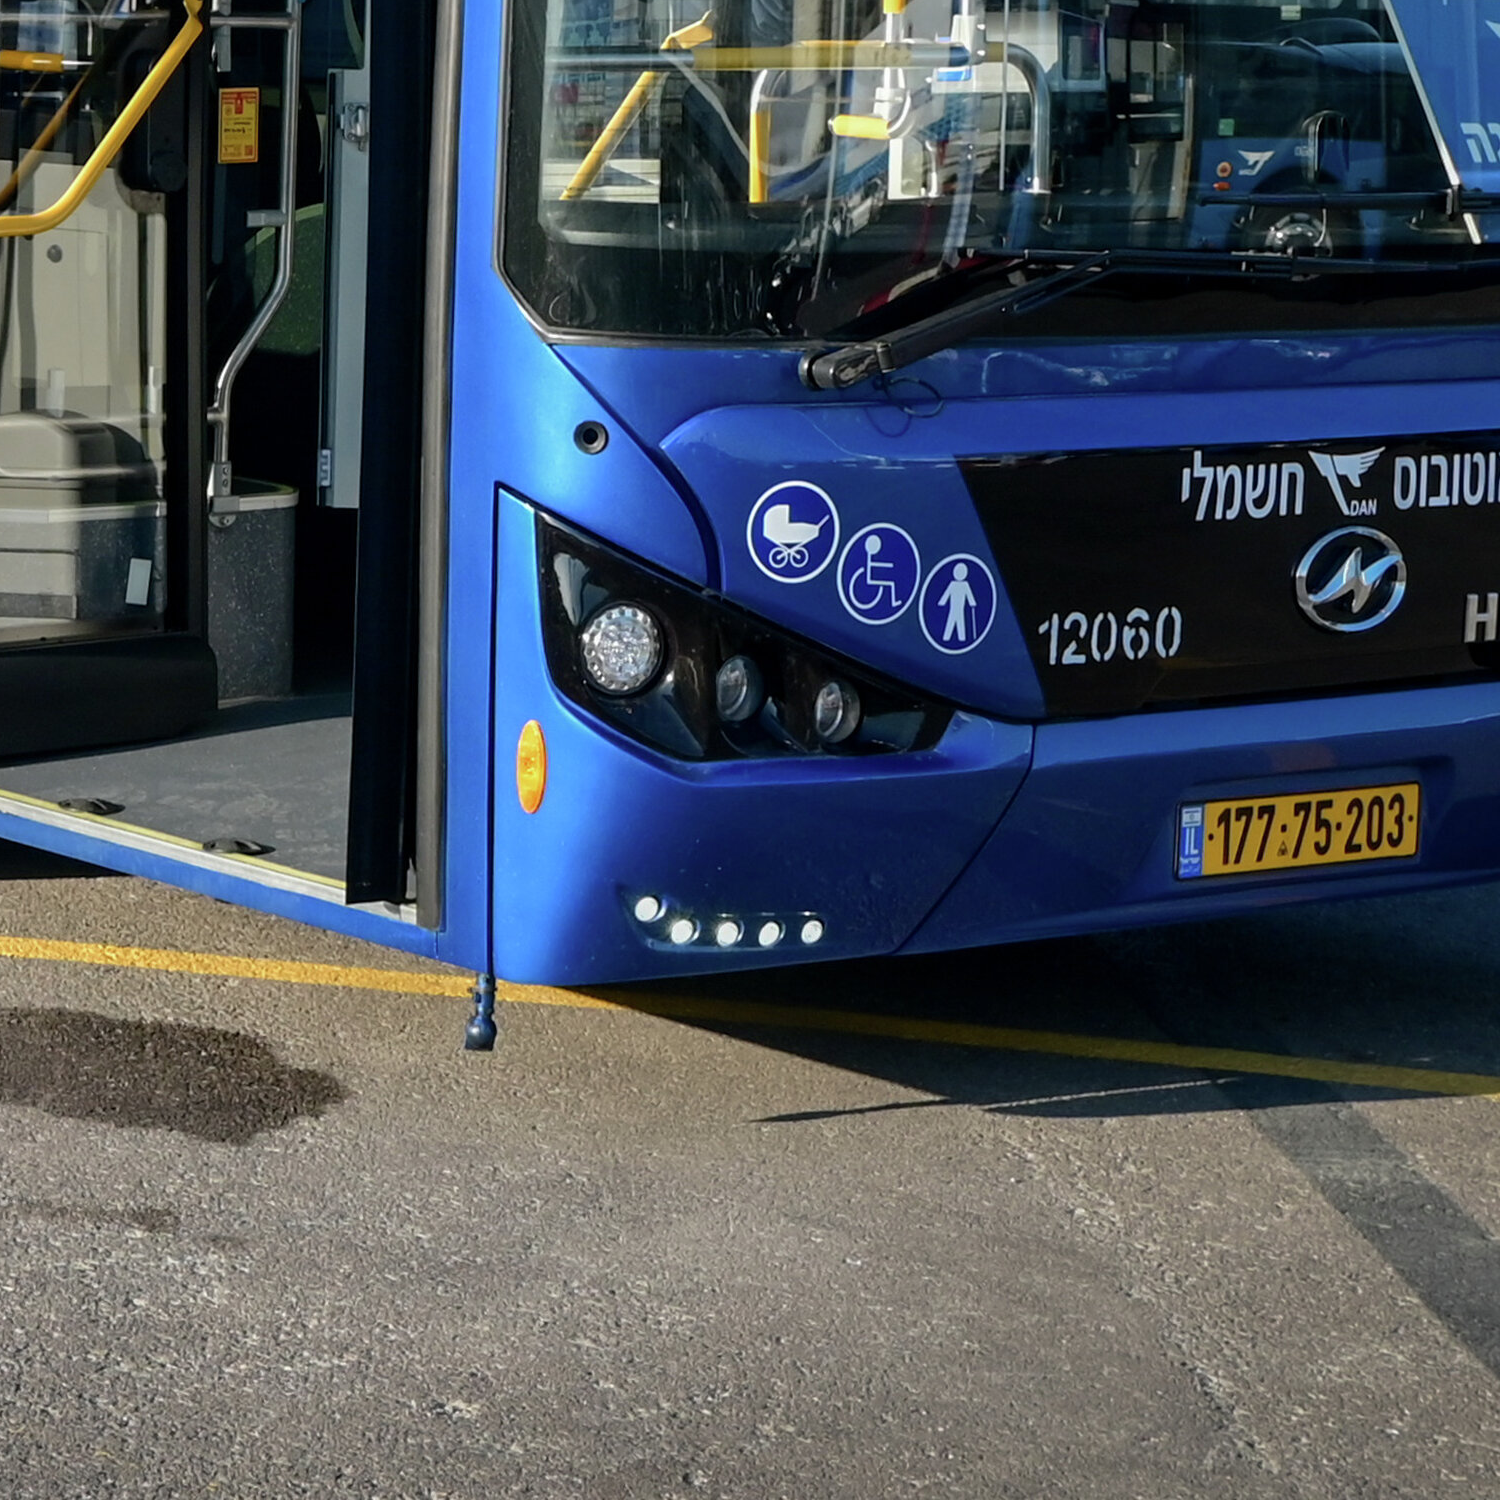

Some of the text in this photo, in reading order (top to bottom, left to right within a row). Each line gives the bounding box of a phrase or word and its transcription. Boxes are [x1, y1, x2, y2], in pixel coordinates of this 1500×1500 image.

[1181, 450, 1500, 521] וטובוס חשמלי
[1349, 499, 1378, 517] DAN
[1038, 606, 1183, 666] 12060
[1463, 592, 1499, 643] H
